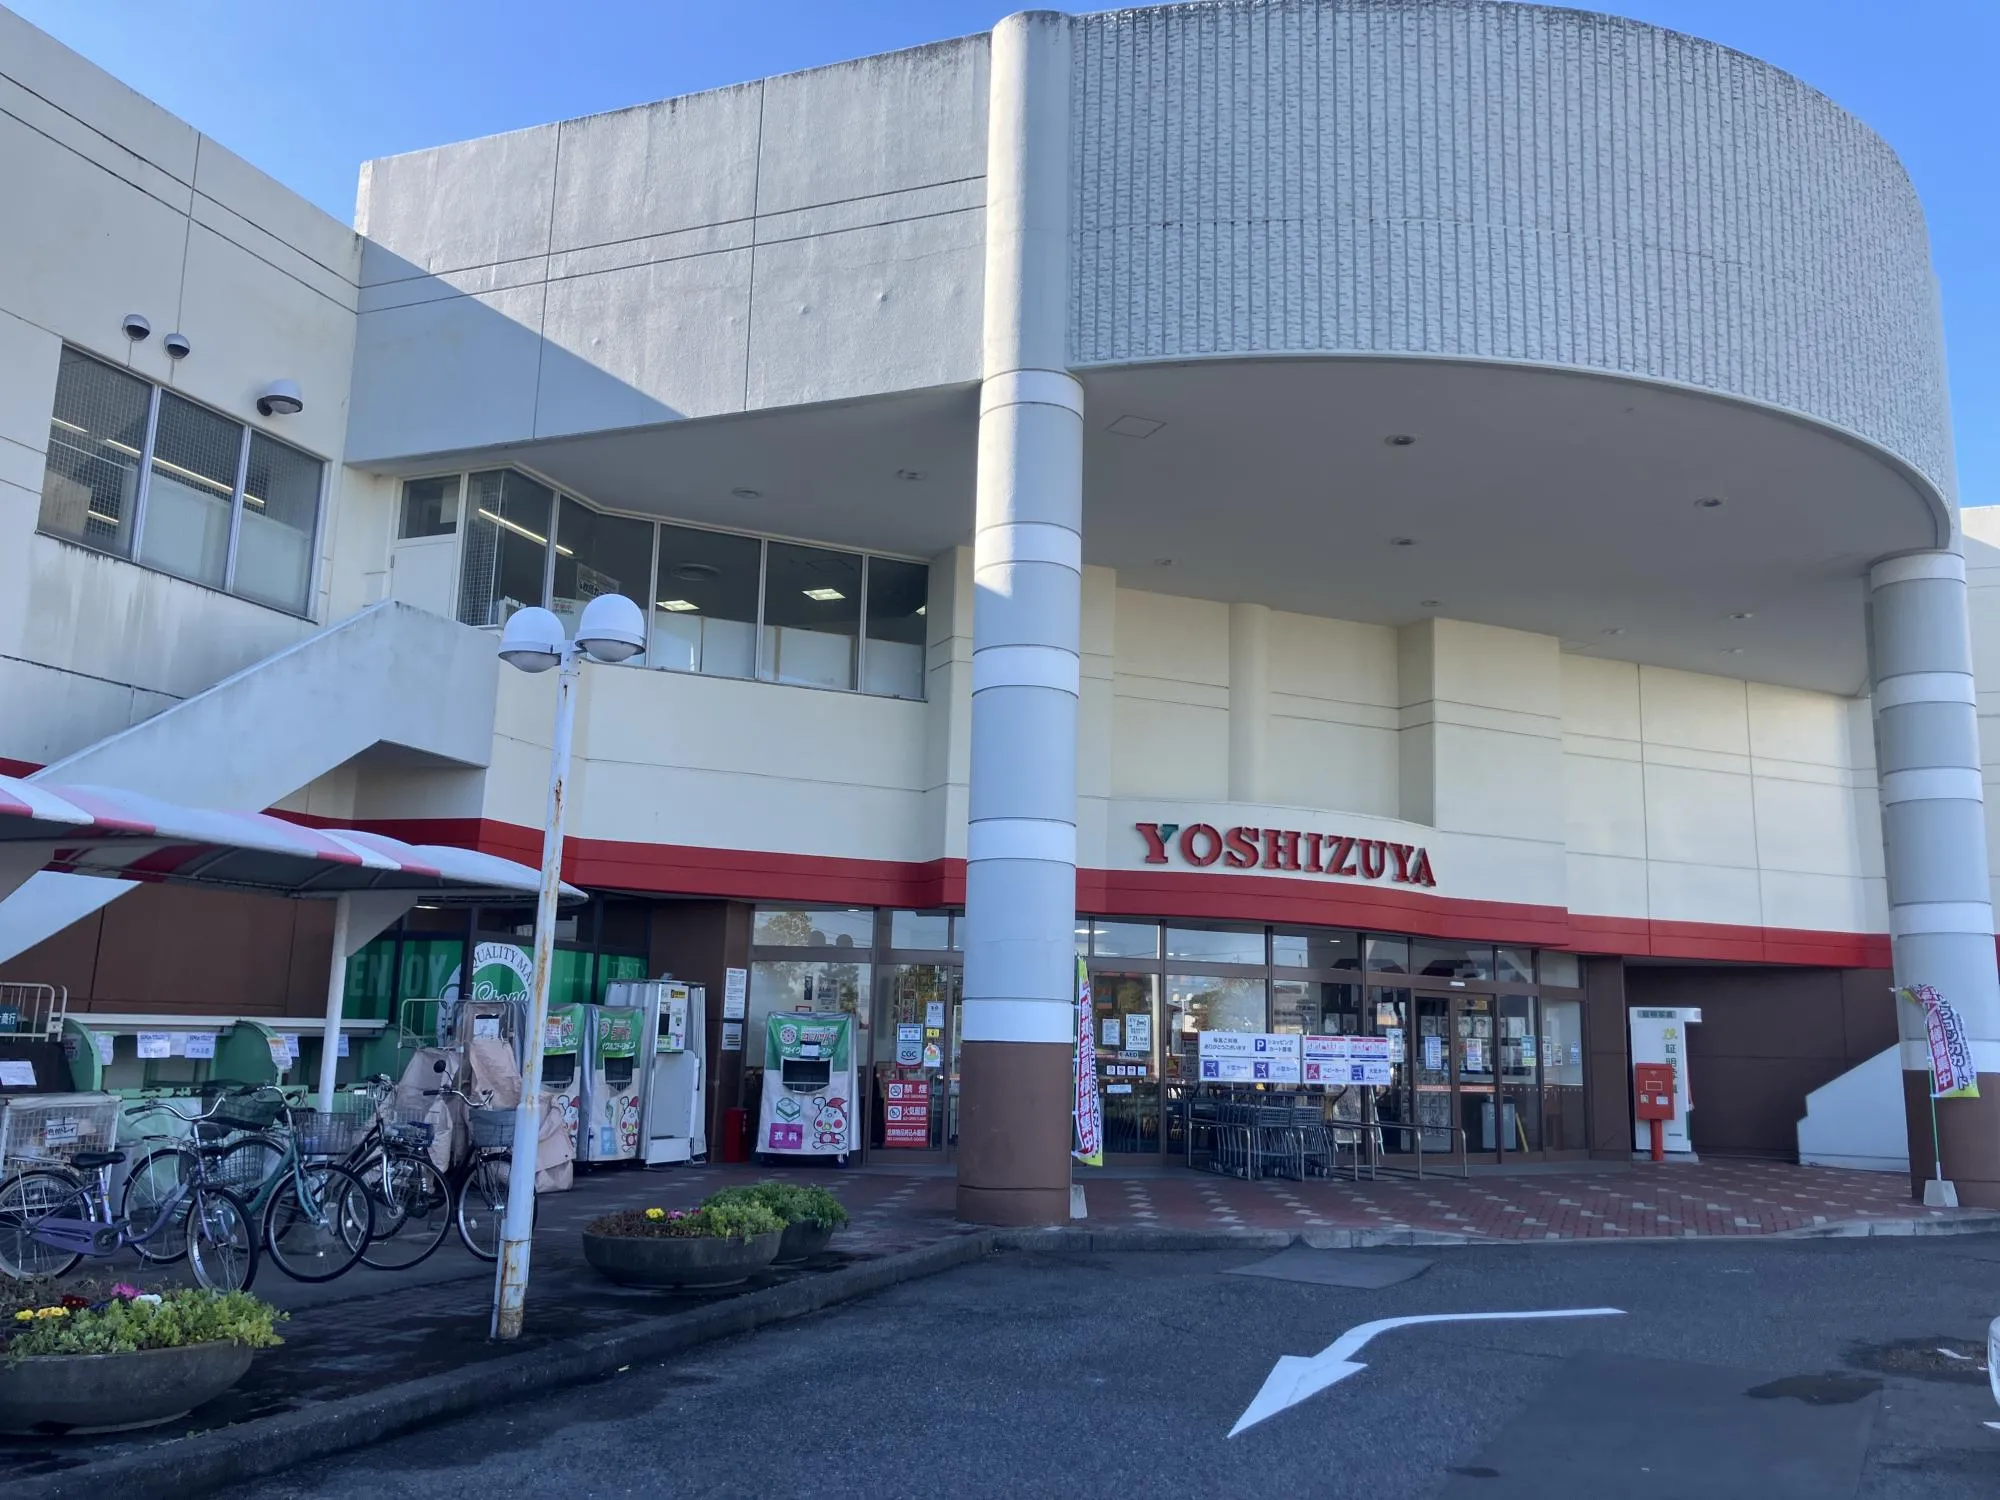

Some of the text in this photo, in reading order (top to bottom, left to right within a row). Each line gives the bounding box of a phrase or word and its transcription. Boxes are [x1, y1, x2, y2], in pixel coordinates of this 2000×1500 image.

[1136, 822, 1437, 887] YOSHIZUYA
[348, 953, 447, 997] ENOY
[774, 1130, 798, 1142] 衣料
